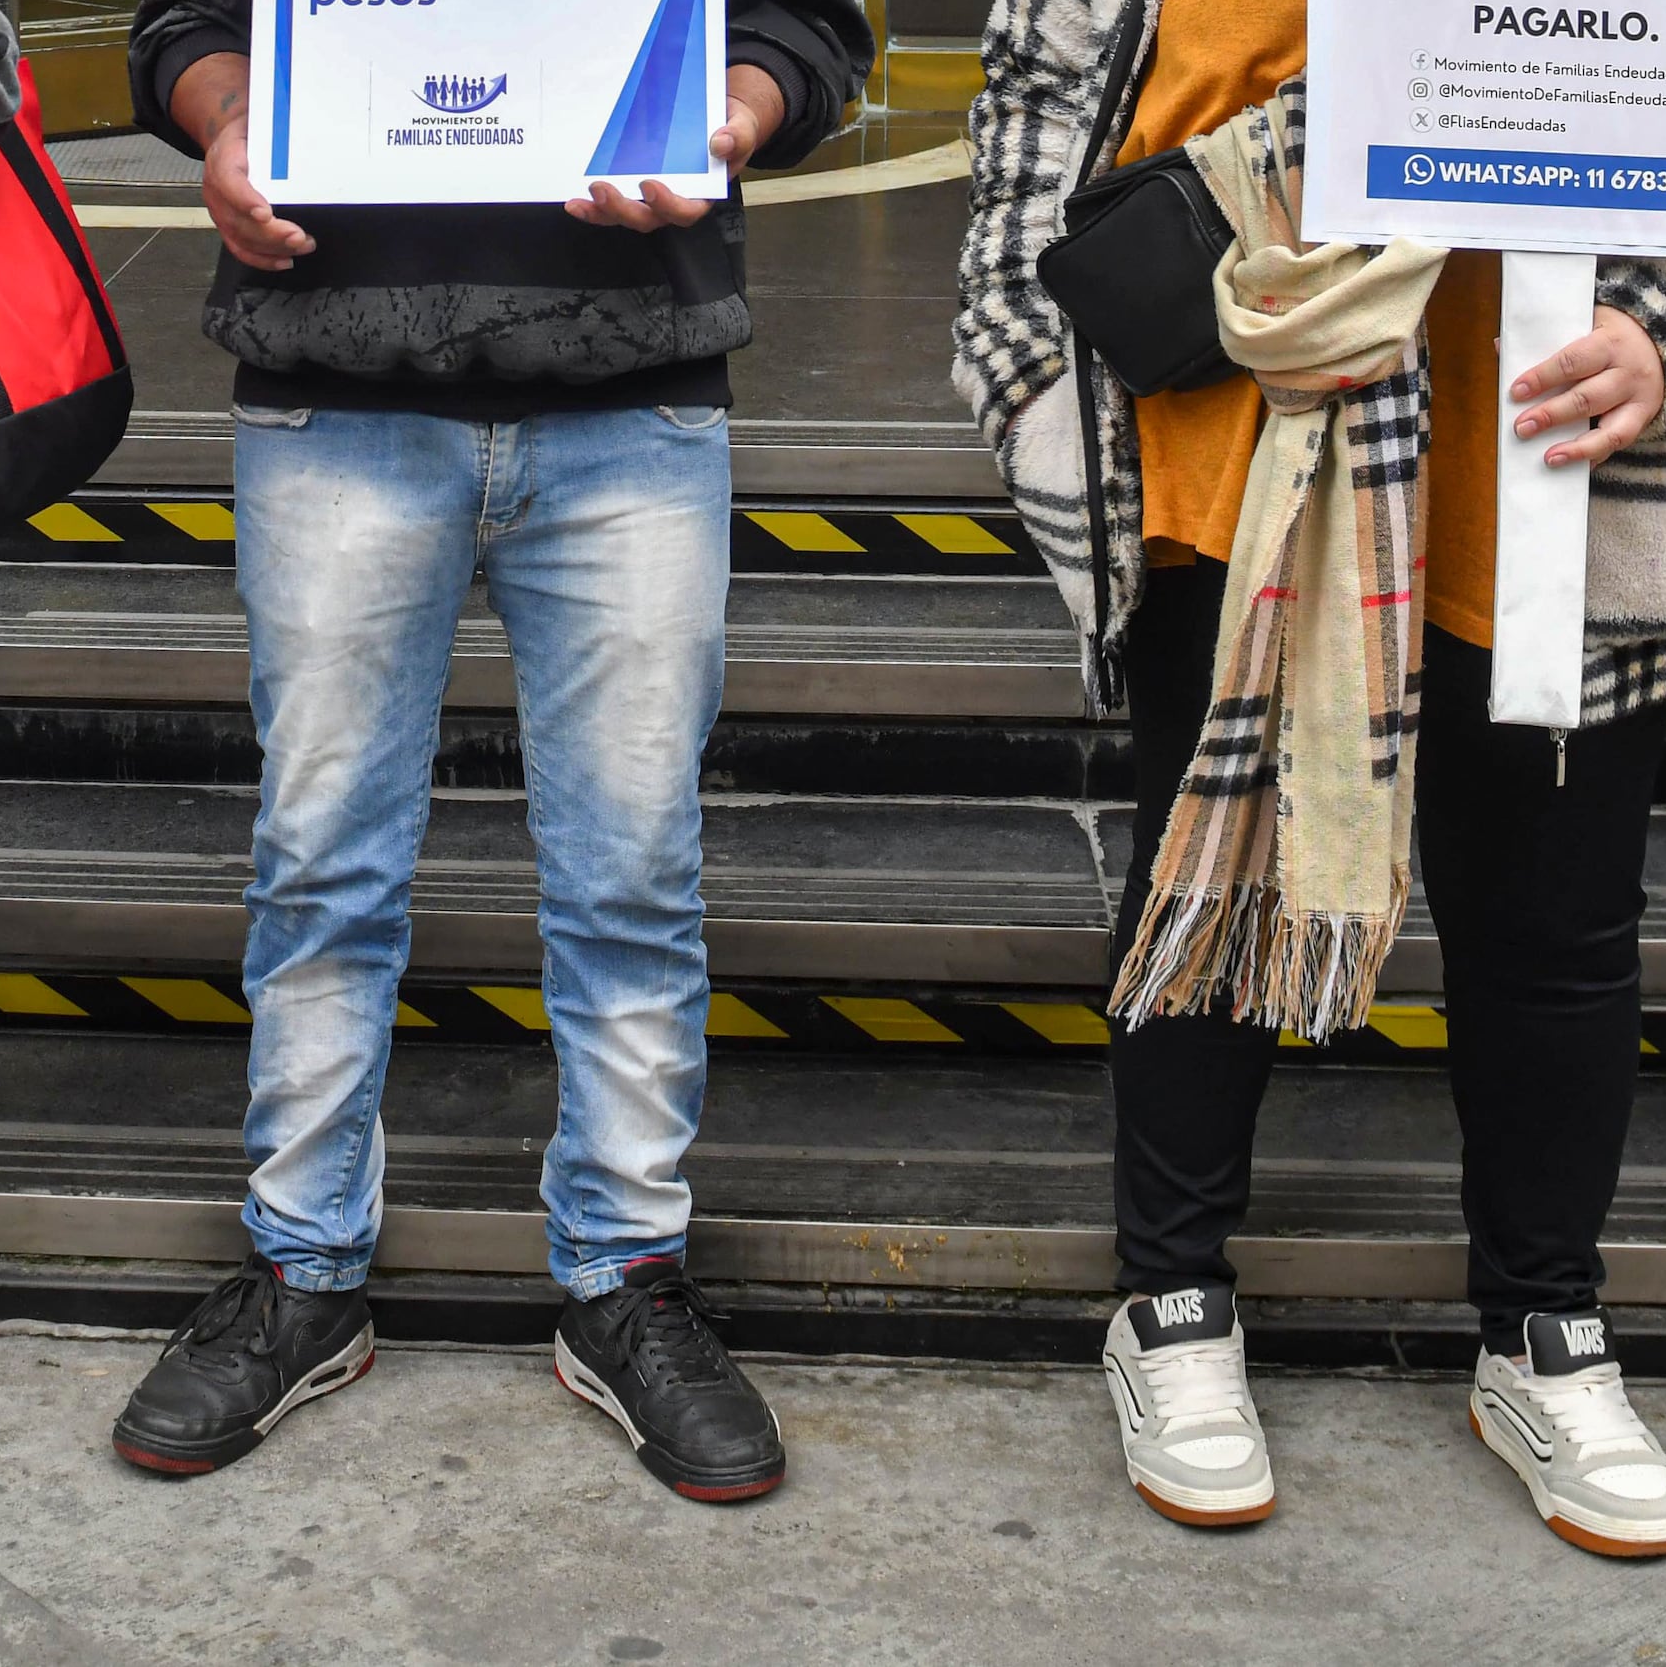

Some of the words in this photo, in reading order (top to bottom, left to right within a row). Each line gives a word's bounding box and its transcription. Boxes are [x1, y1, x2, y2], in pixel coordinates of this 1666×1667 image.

[1473, 4, 1659, 42] PAGARLO.
[1434, 57, 1517, 73] Movimiento
[1521, 60, 1541, 74] de
[1544, 61, 1599, 77] Familias
[411, 116, 483, 126] MOVIMIENTO
[485, 116, 499, 125] DE
[1437, 113, 1566, 133] @FliasEndeudadas
[387, 128, 442, 146] FAMILIAS
[445, 127, 524, 146] ENDEUDADAS
[1438, 161, 1580, 188] WHATSAPP:
[1586, 168, 1605, 189] 11
[1151, 1287, 1205, 1330] VANS
[1559, 1316, 1605, 1357] VANS
